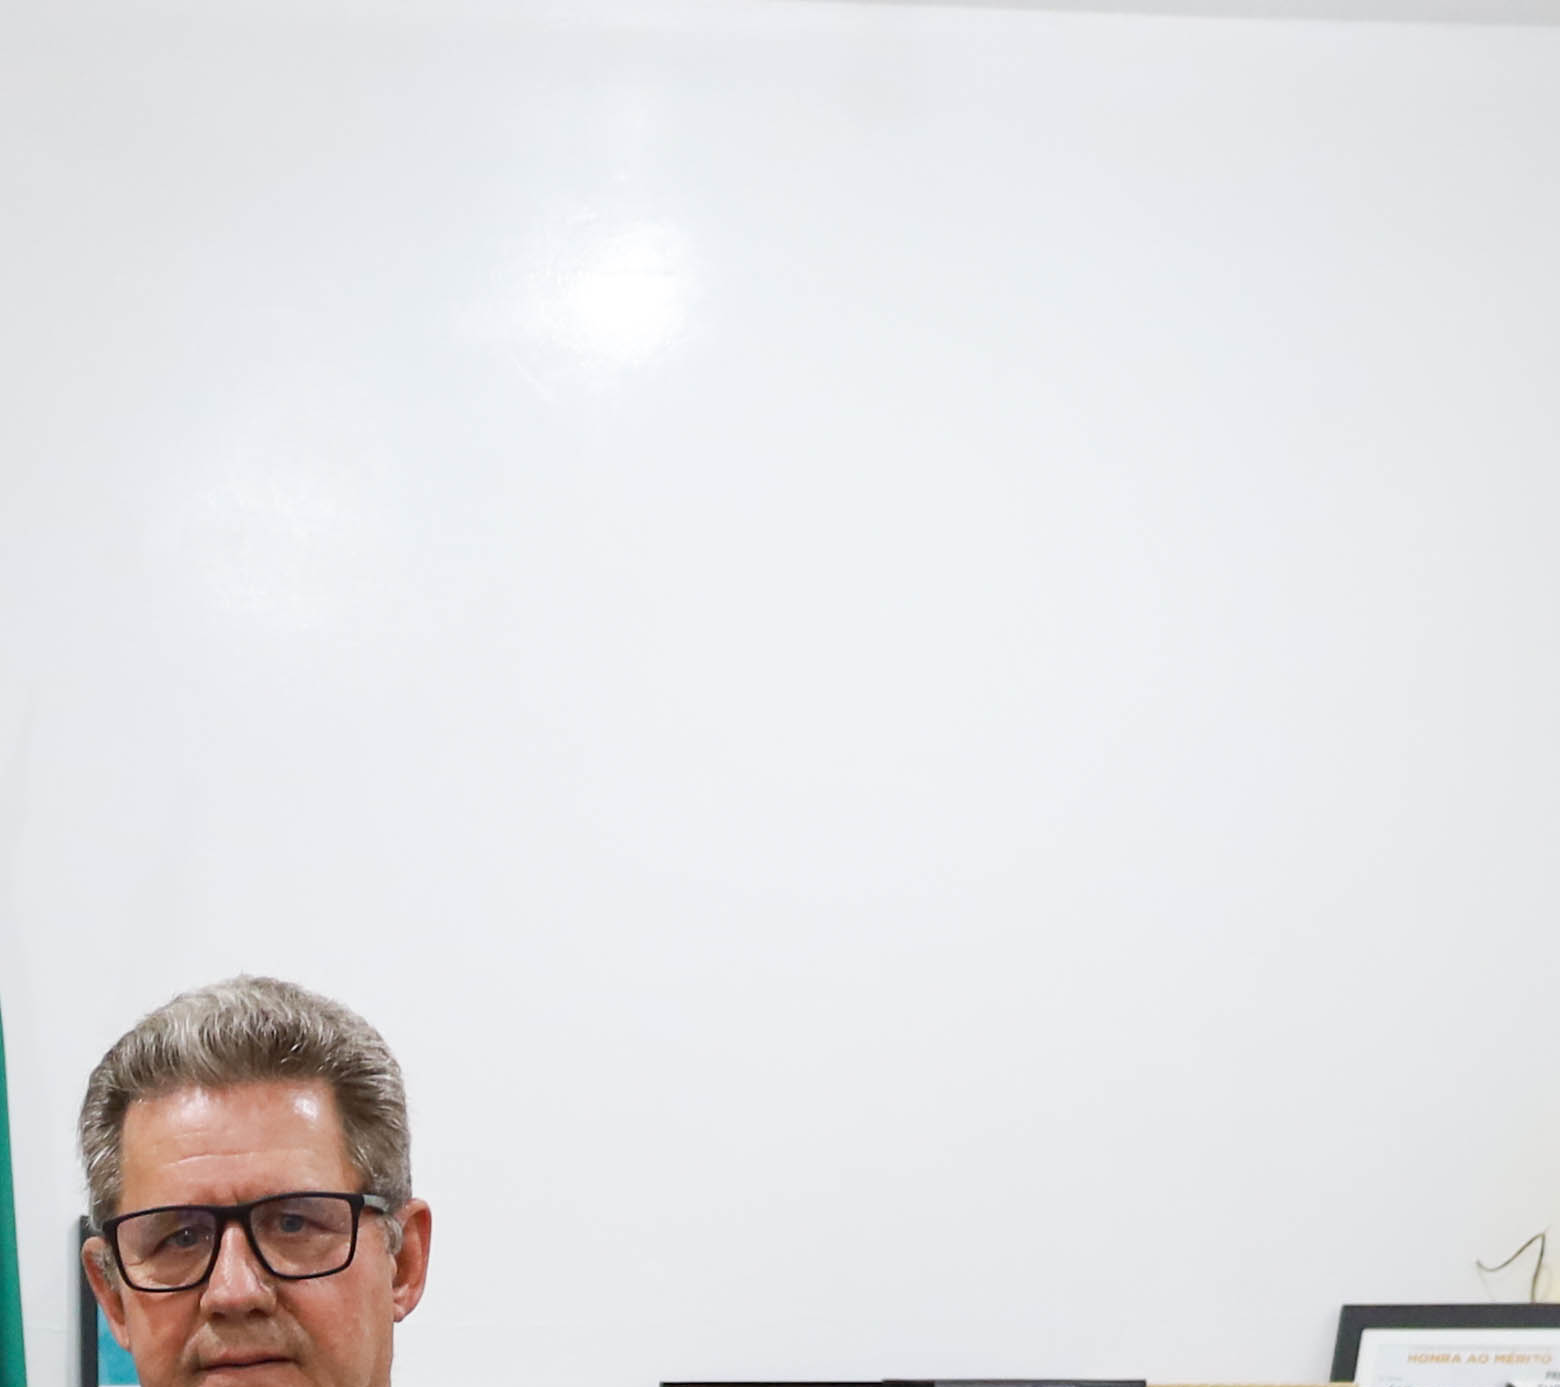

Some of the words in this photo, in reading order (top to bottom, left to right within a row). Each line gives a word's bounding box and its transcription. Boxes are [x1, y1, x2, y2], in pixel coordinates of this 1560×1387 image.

[1407, 1353, 1462, 1364] HONRA
[1467, 1353, 1489, 1364] AO
[1494, 1351, 1553, 1364] MÉRITO
